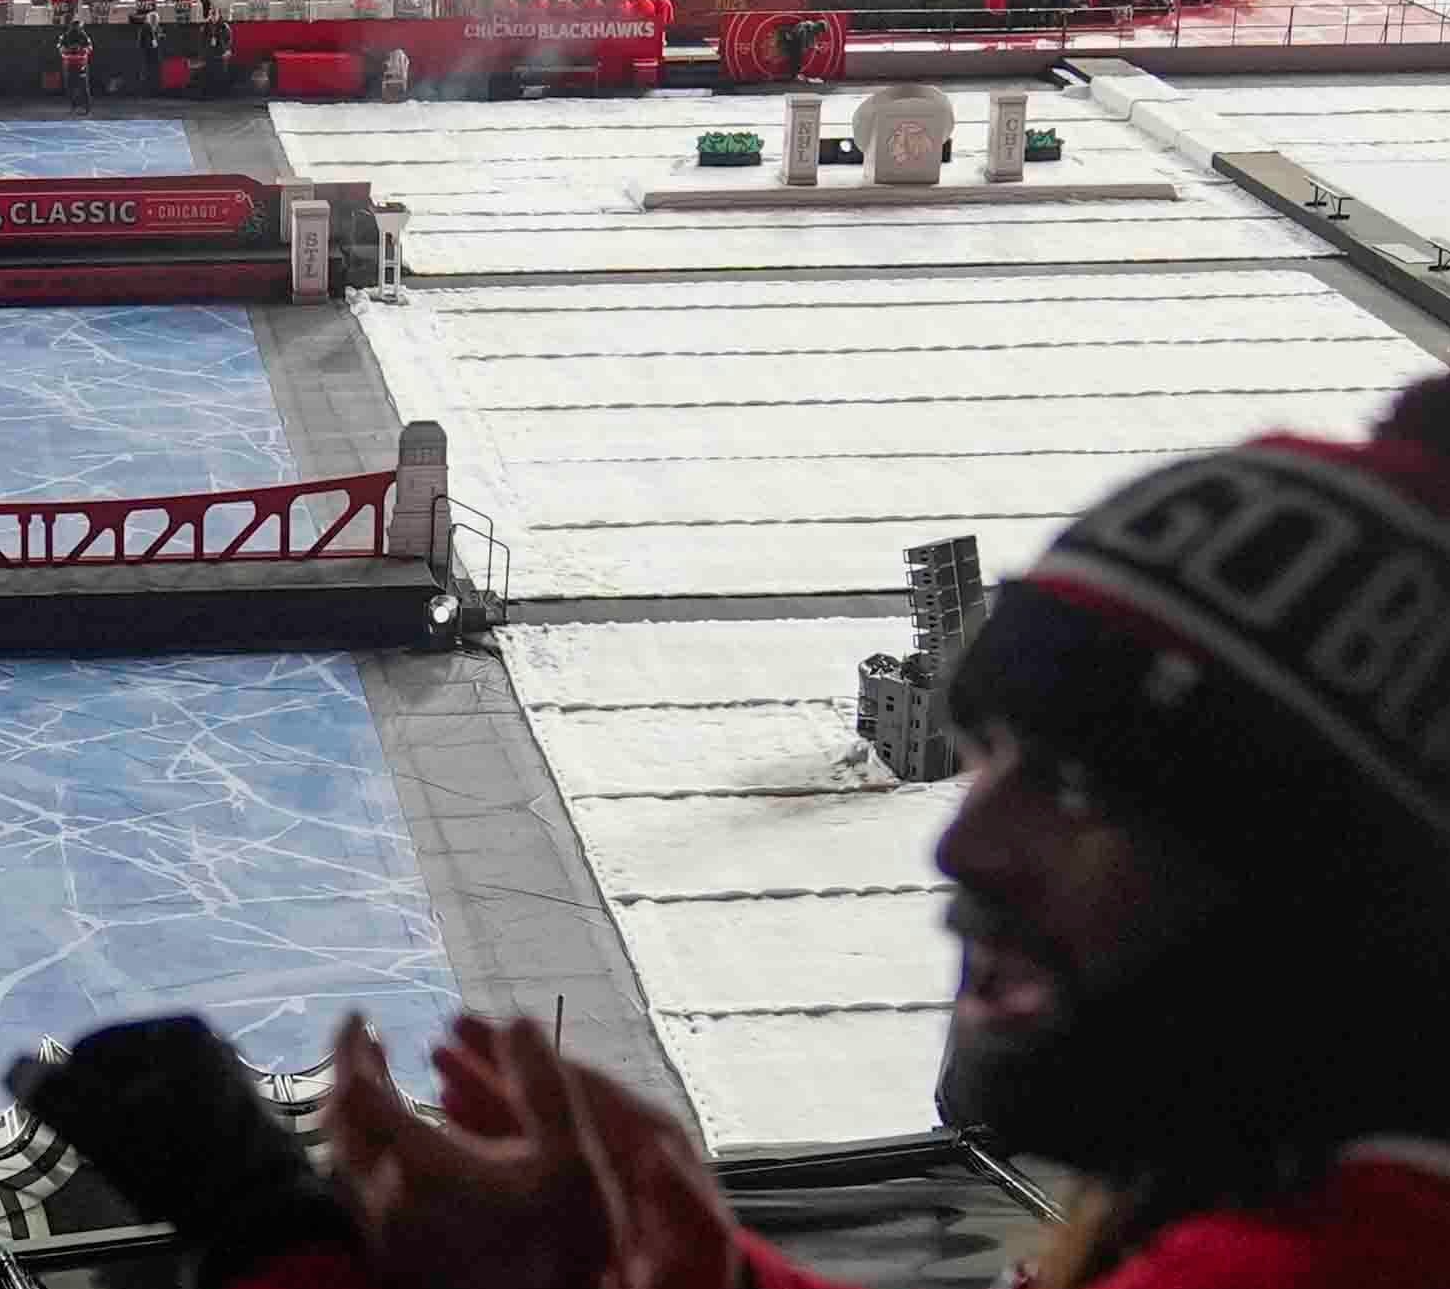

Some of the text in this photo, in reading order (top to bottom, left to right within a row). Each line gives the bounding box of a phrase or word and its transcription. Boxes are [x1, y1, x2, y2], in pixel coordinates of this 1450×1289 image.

[536, 21, 655, 40] BLACKHAWKS
[10, 200, 137, 225] CLASSIC
[157, 205, 217, 219] CHICAGO
